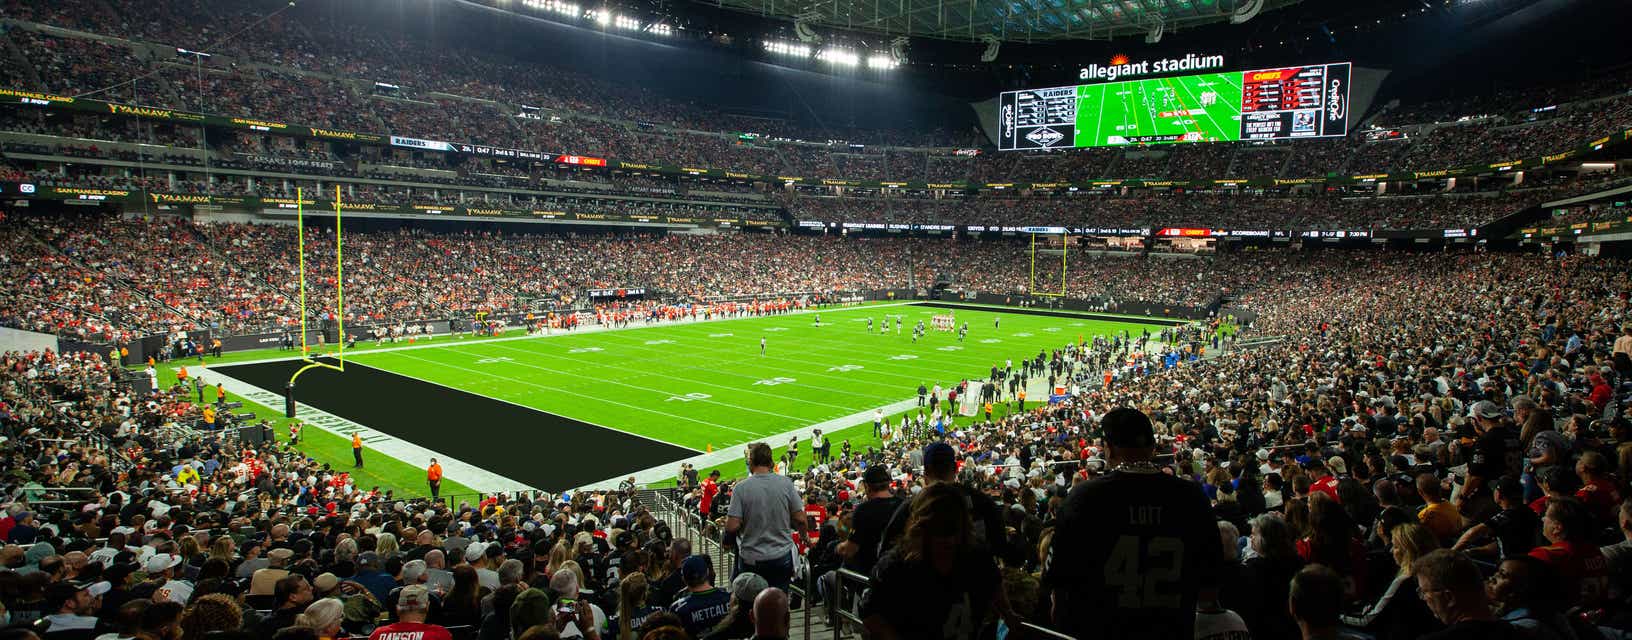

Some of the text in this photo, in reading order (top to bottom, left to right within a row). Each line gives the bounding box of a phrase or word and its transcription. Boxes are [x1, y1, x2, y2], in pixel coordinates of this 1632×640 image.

[1080, 53, 1224, 80] allegiant stadium
[1253, 71, 1282, 81] CHIEFS
[15, 91, 45, 99] MANUEL
[46, 95, 74, 103] CASINO
[1043, 89, 1073, 98] RAIDERS
[395, 138, 426, 147] RAIDERS
[1103, 534, 1185, 609] 42
[380, 631, 424, 640] DAWSON
